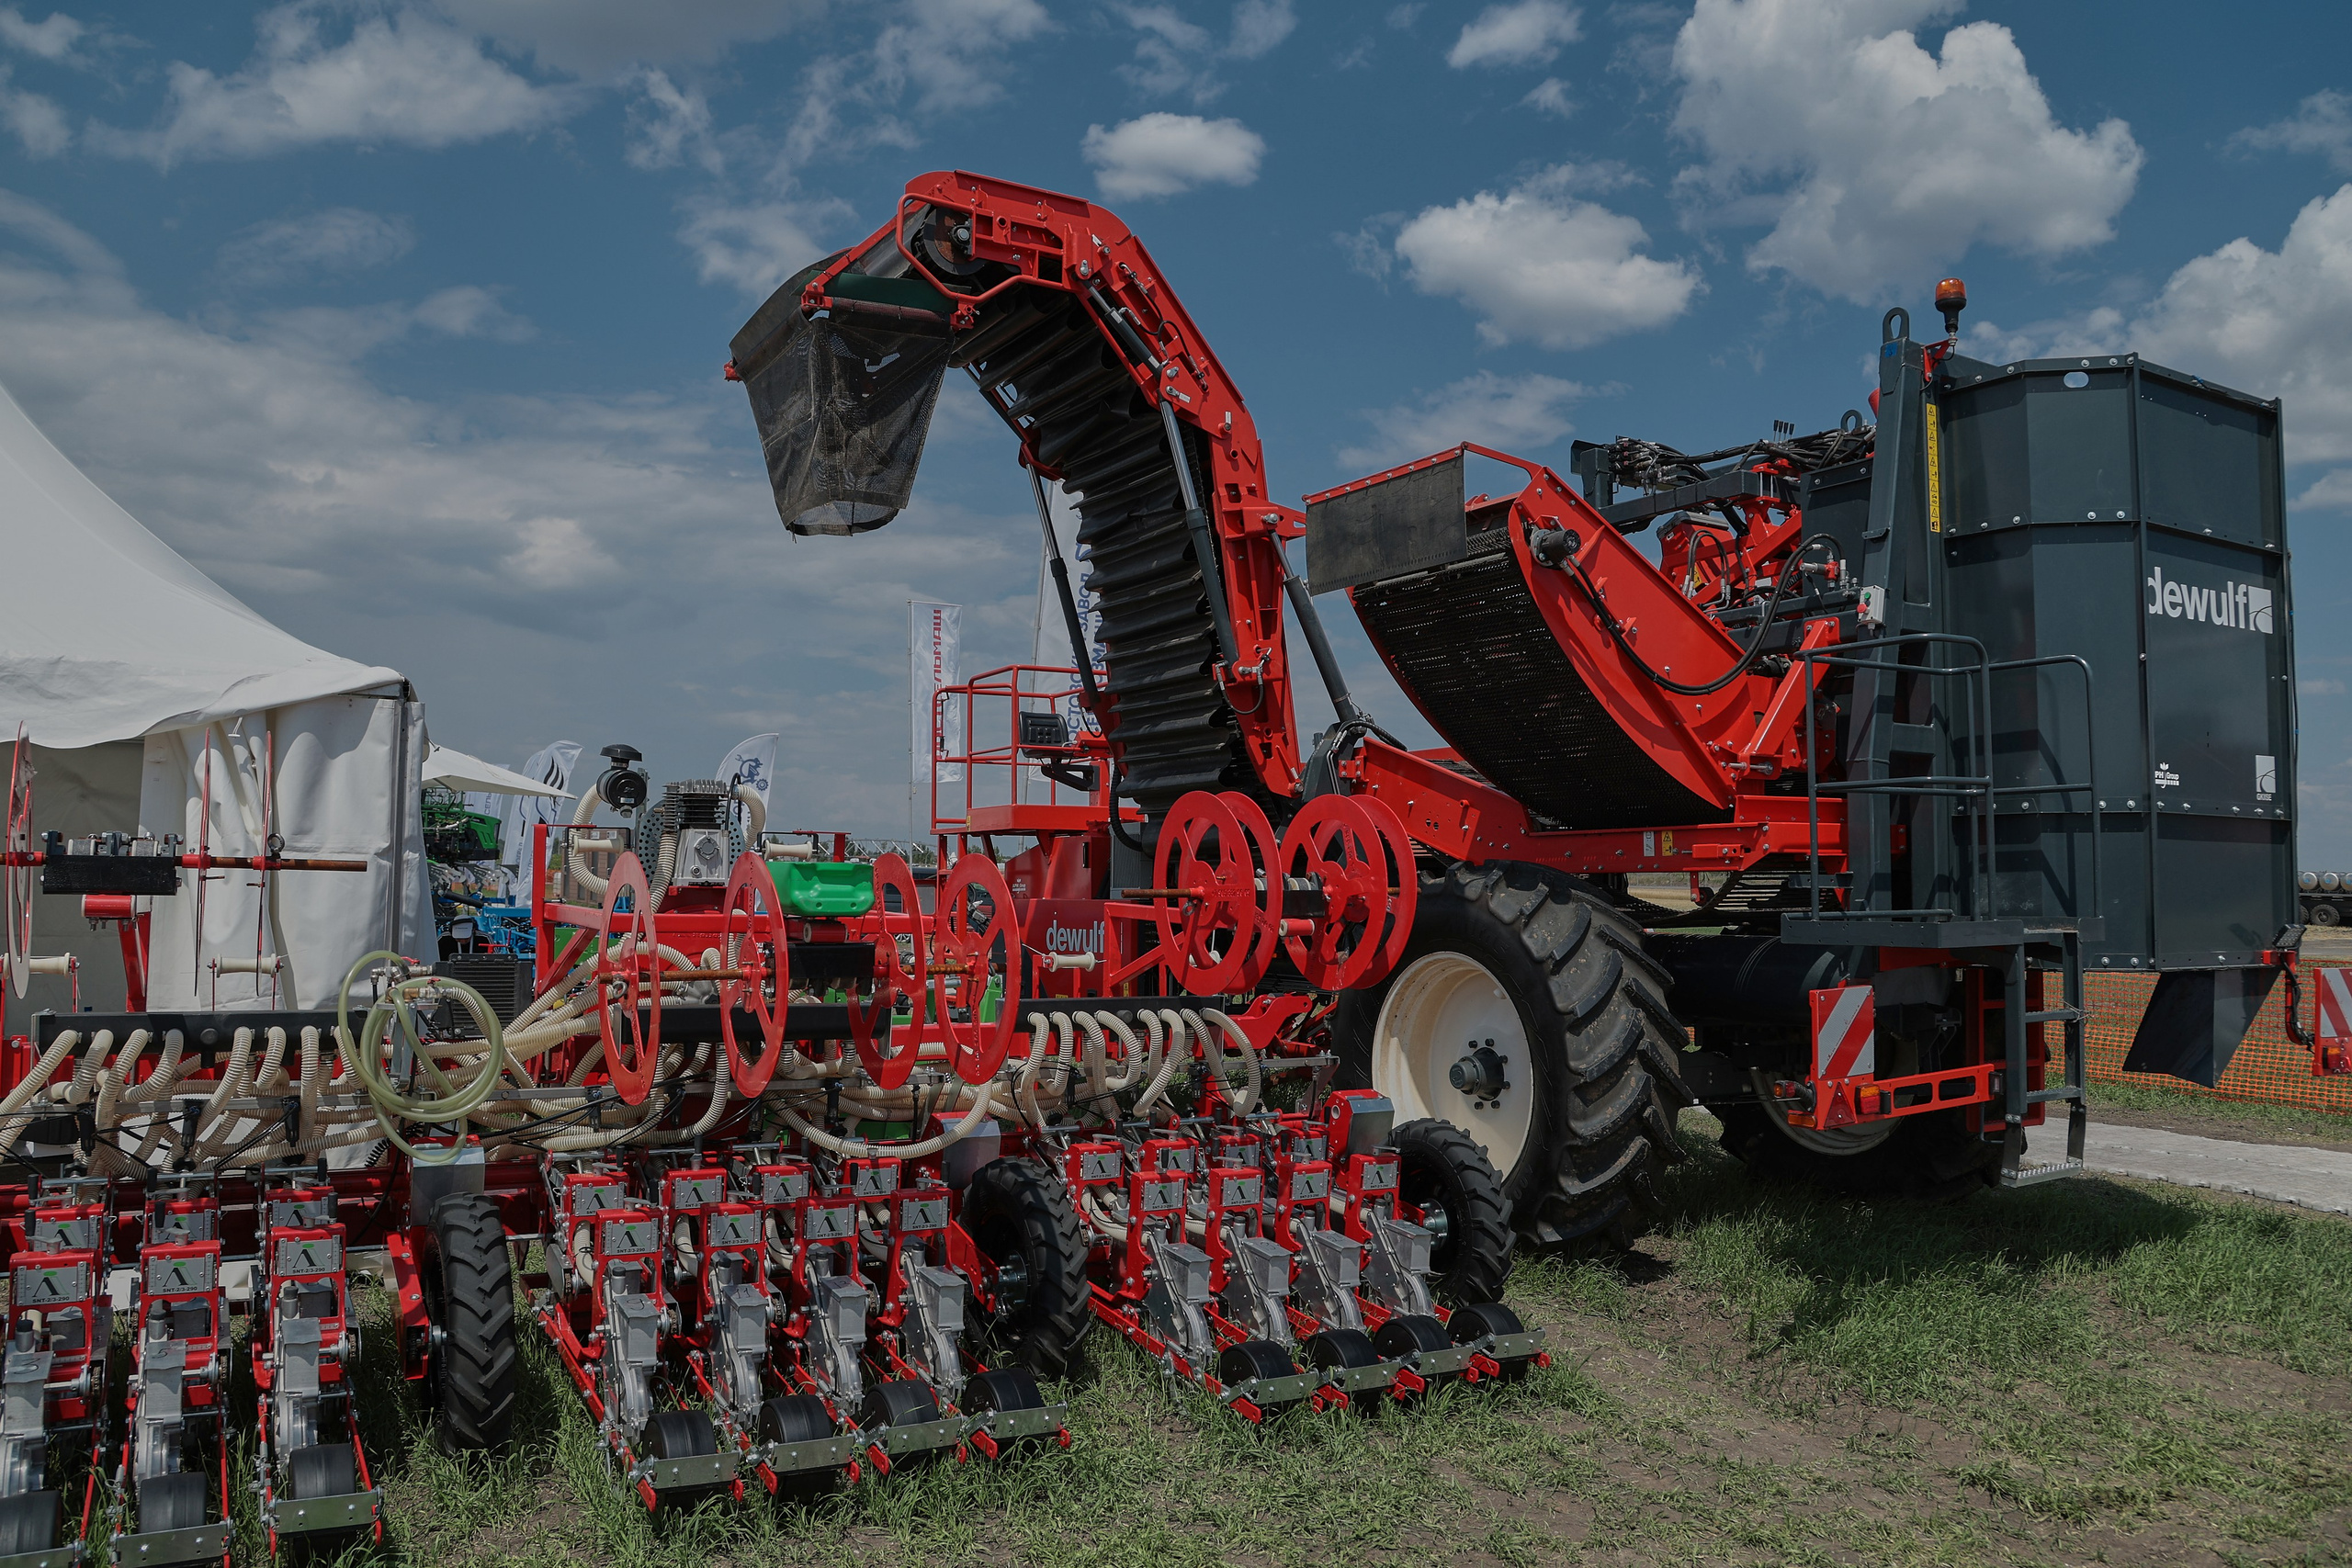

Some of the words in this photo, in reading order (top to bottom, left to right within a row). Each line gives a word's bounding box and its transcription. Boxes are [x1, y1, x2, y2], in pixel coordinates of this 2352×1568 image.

[2147, 567, 2247, 629] dewulf
[1046, 919, 1105, 953] dewulf
[292, 1267, 326, 1275] SNT-2/3-290
[163, 1286, 198, 1294] SNT-2/3-290
[32, 1296, 71, 1304] SNT-2/3-290
